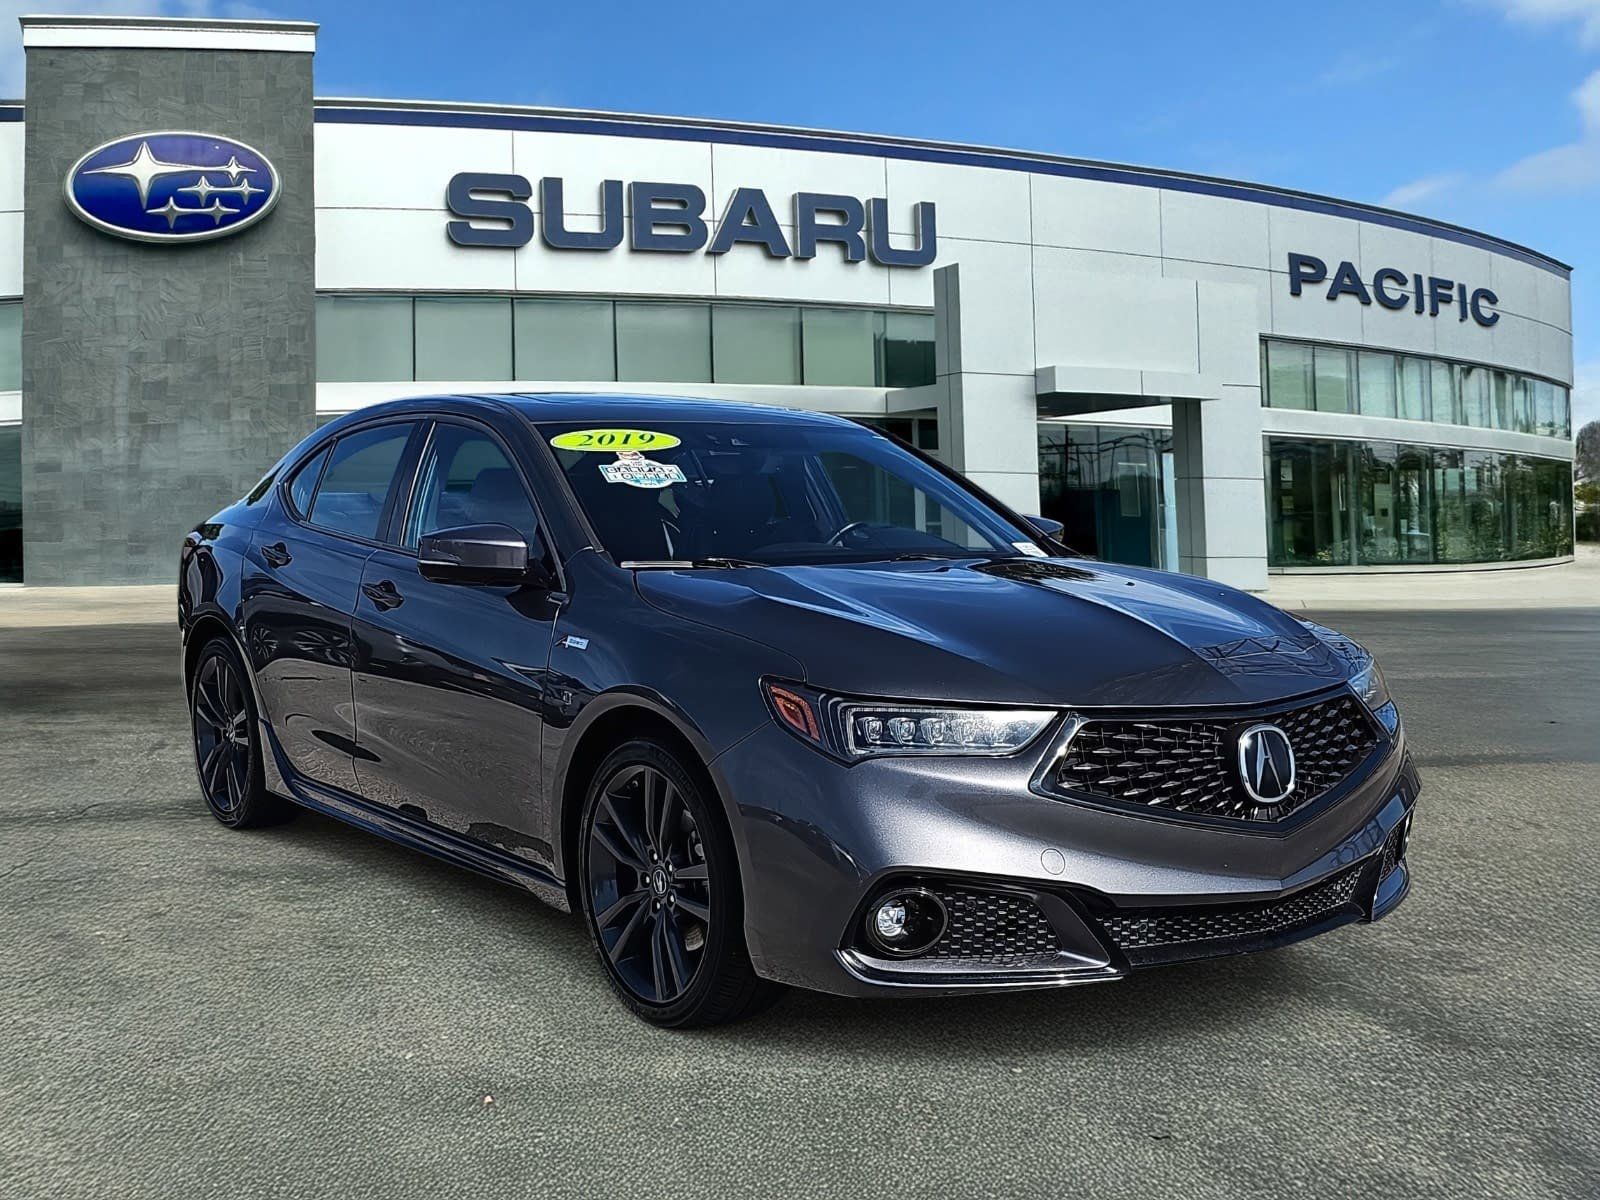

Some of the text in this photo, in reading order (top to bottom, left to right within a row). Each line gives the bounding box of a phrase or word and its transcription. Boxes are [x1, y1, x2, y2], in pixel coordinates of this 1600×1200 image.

[446, 172, 937, 267] SUBARU
[1288, 252, 1500, 327] PACIFIC
[579, 433, 656, 446] 2019
